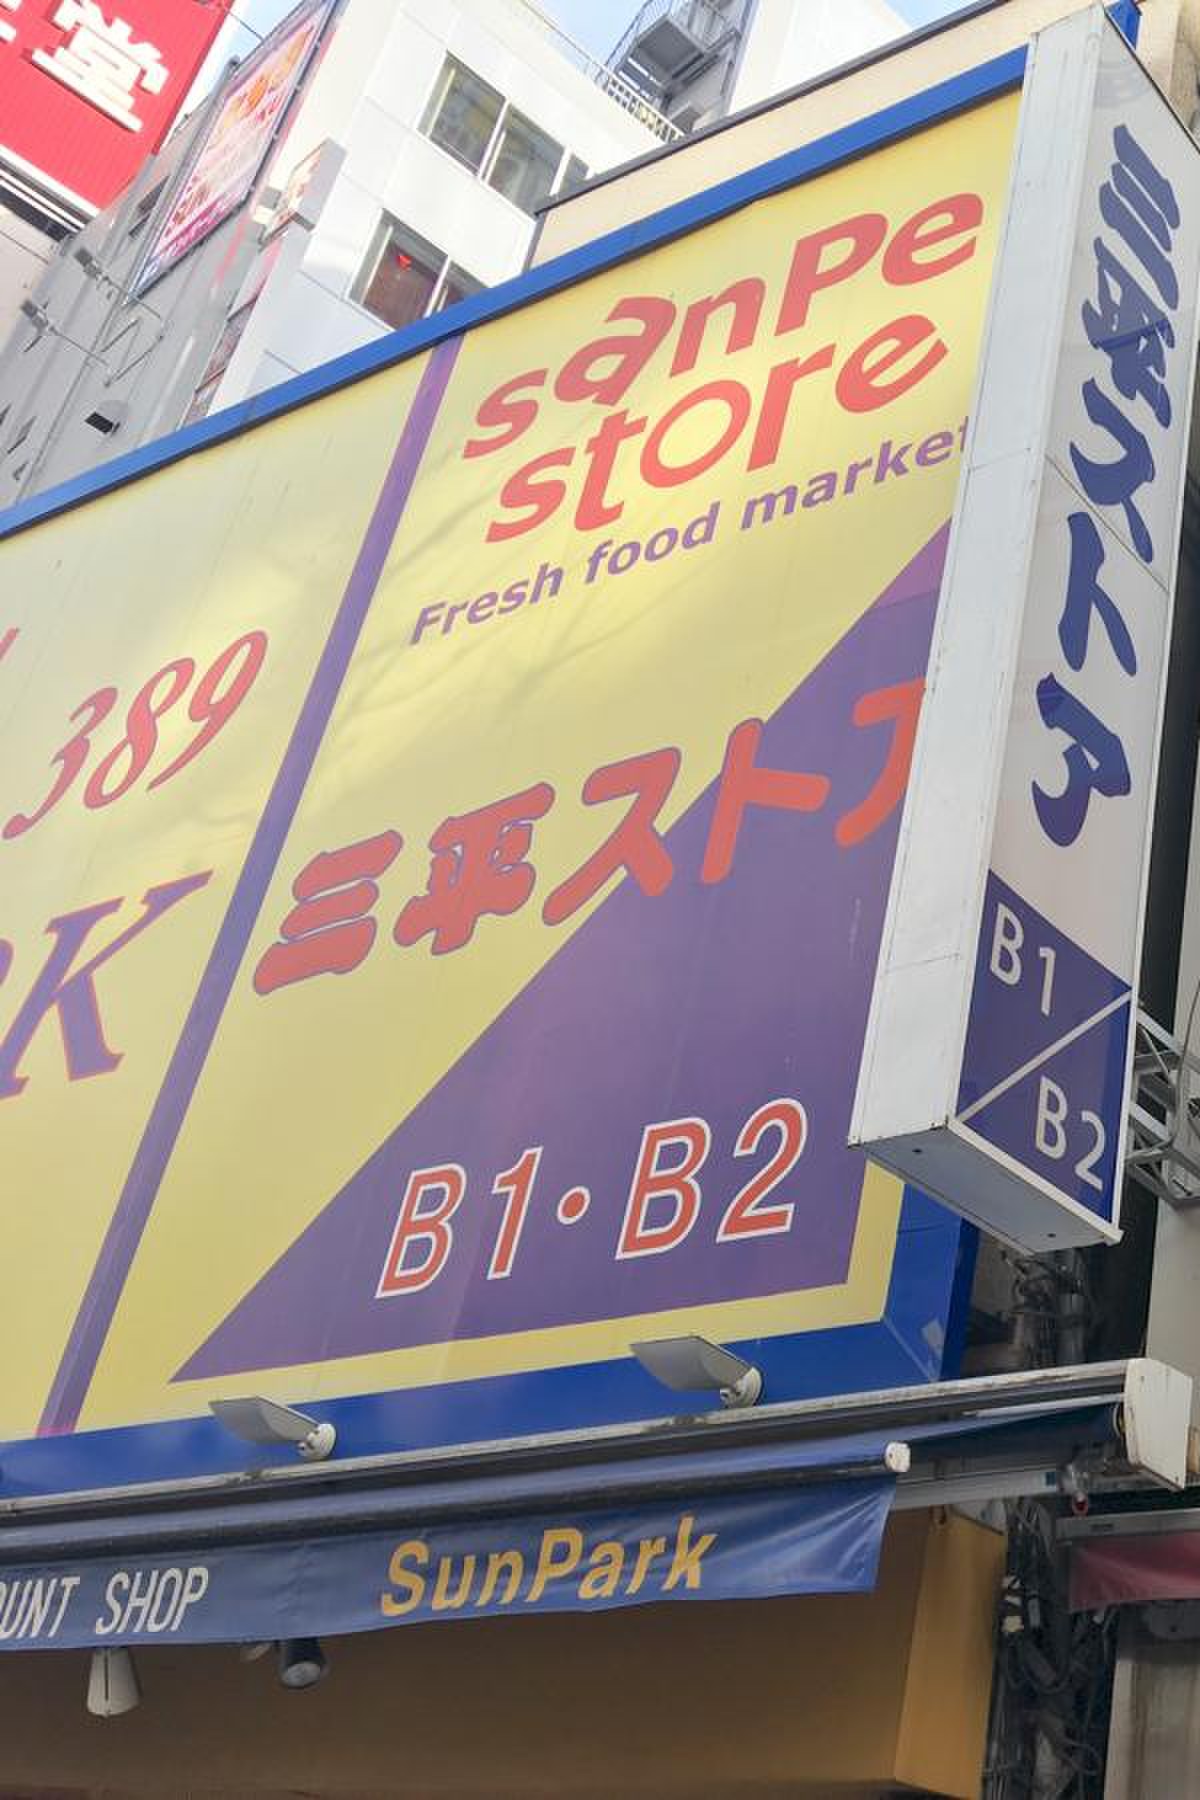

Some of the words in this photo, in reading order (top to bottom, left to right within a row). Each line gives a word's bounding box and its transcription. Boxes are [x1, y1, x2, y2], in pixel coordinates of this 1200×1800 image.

[0, 0, 170, 134] 堂
[484, 313, 949, 544] store
[1031, 124, 1181, 848] 三平ストア
[410, 562, 564, 646] Fresh
[584, 502, 721, 583] food
[2, 630, 269, 840] 389
[0, 869, 214, 1100] K
[989, 902, 1056, 1018] B1
[1034, 1075, 1107, 1190] B2
[95, 1564, 209, 1635] SHOP
[381, 1515, 718, 1617] SunPark
